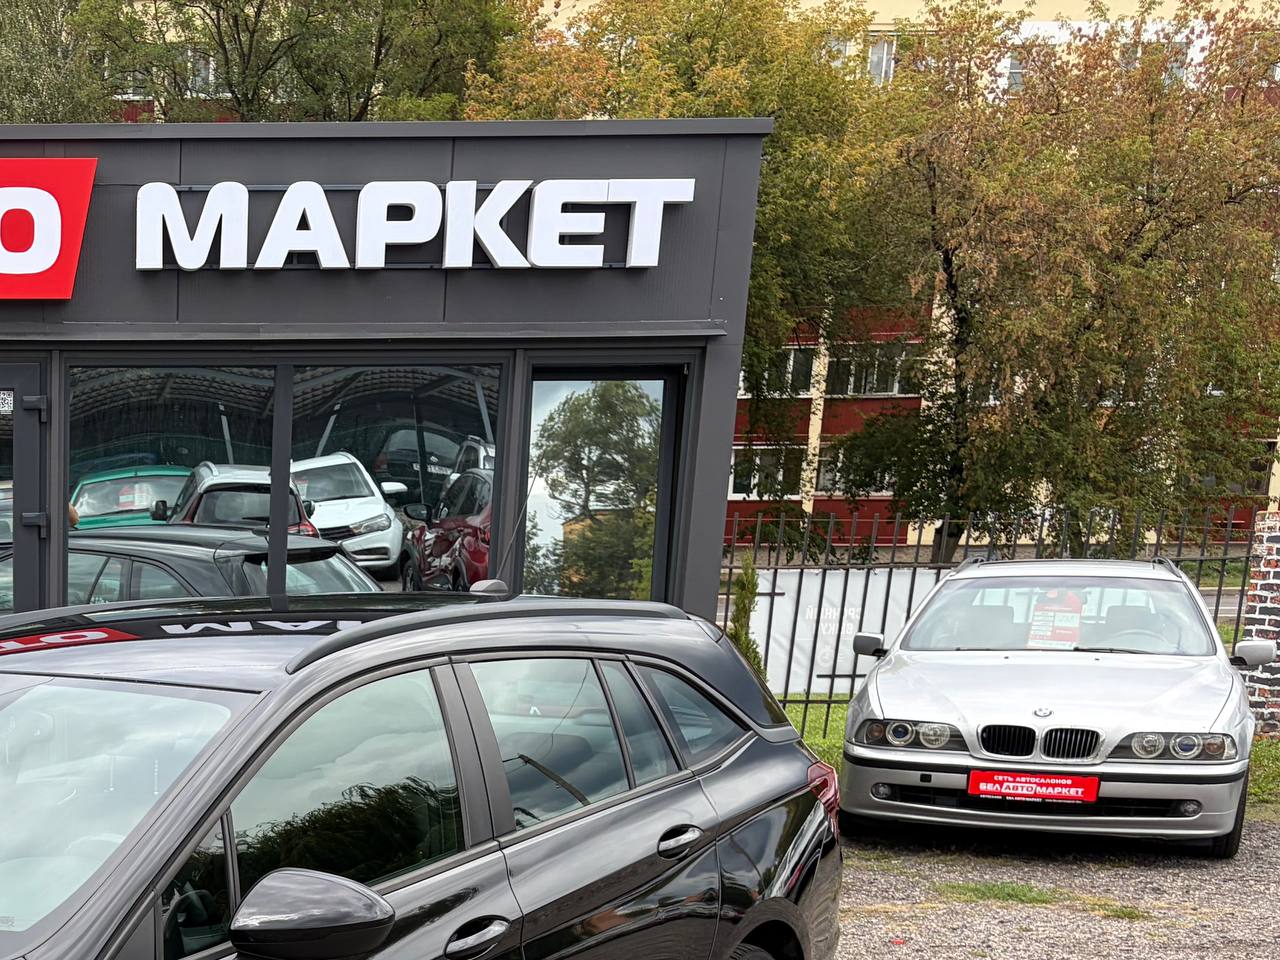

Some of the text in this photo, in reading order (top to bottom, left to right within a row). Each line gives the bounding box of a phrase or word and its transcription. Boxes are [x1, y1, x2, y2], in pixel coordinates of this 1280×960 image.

[135, 178, 696, 272] МАРКЕТ
[1015, 777, 1073, 785] АВТОСАЛОНОВ
[979, 782, 1085, 797] БЕЛ АВТО МАРКЕТ
